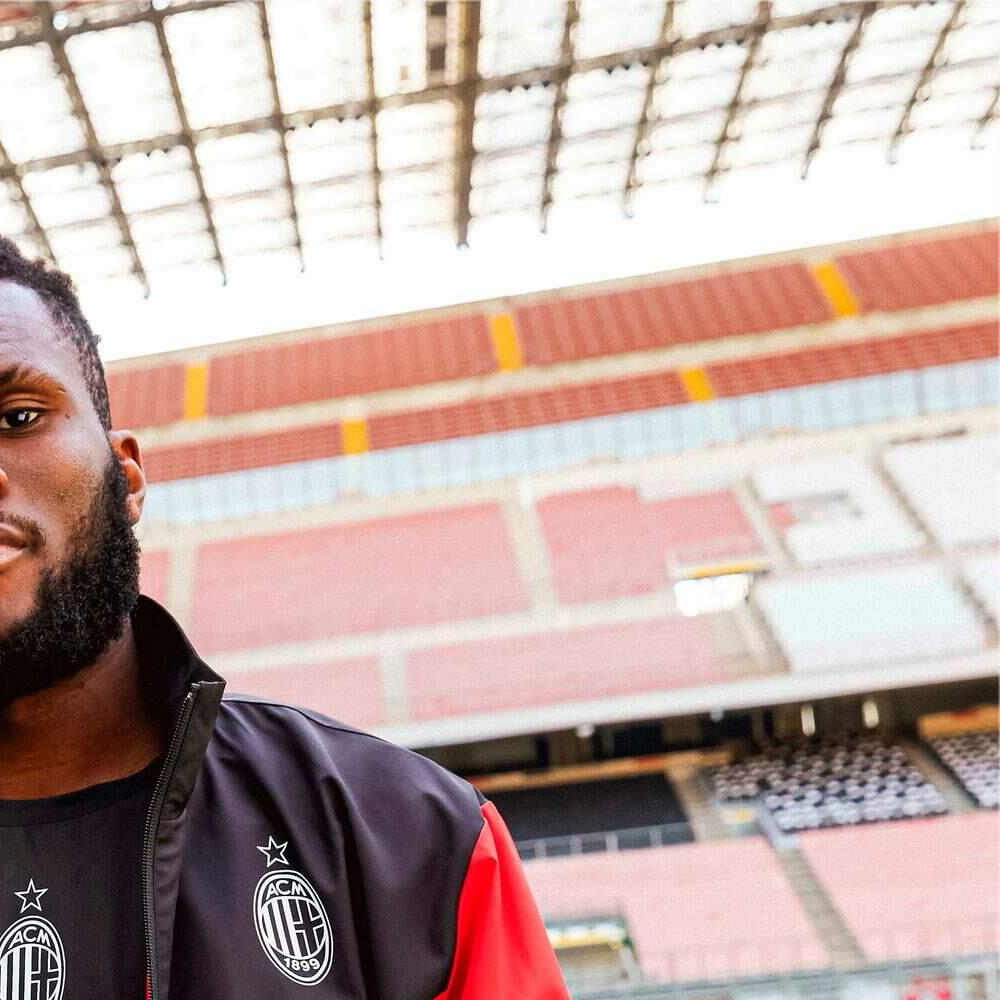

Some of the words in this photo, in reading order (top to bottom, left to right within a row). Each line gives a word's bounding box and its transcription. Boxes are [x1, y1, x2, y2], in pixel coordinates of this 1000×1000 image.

[266, 880, 307, 900] ACM
[8, 926, 51, 949] ACM
[284, 957, 320, 971] 1899
